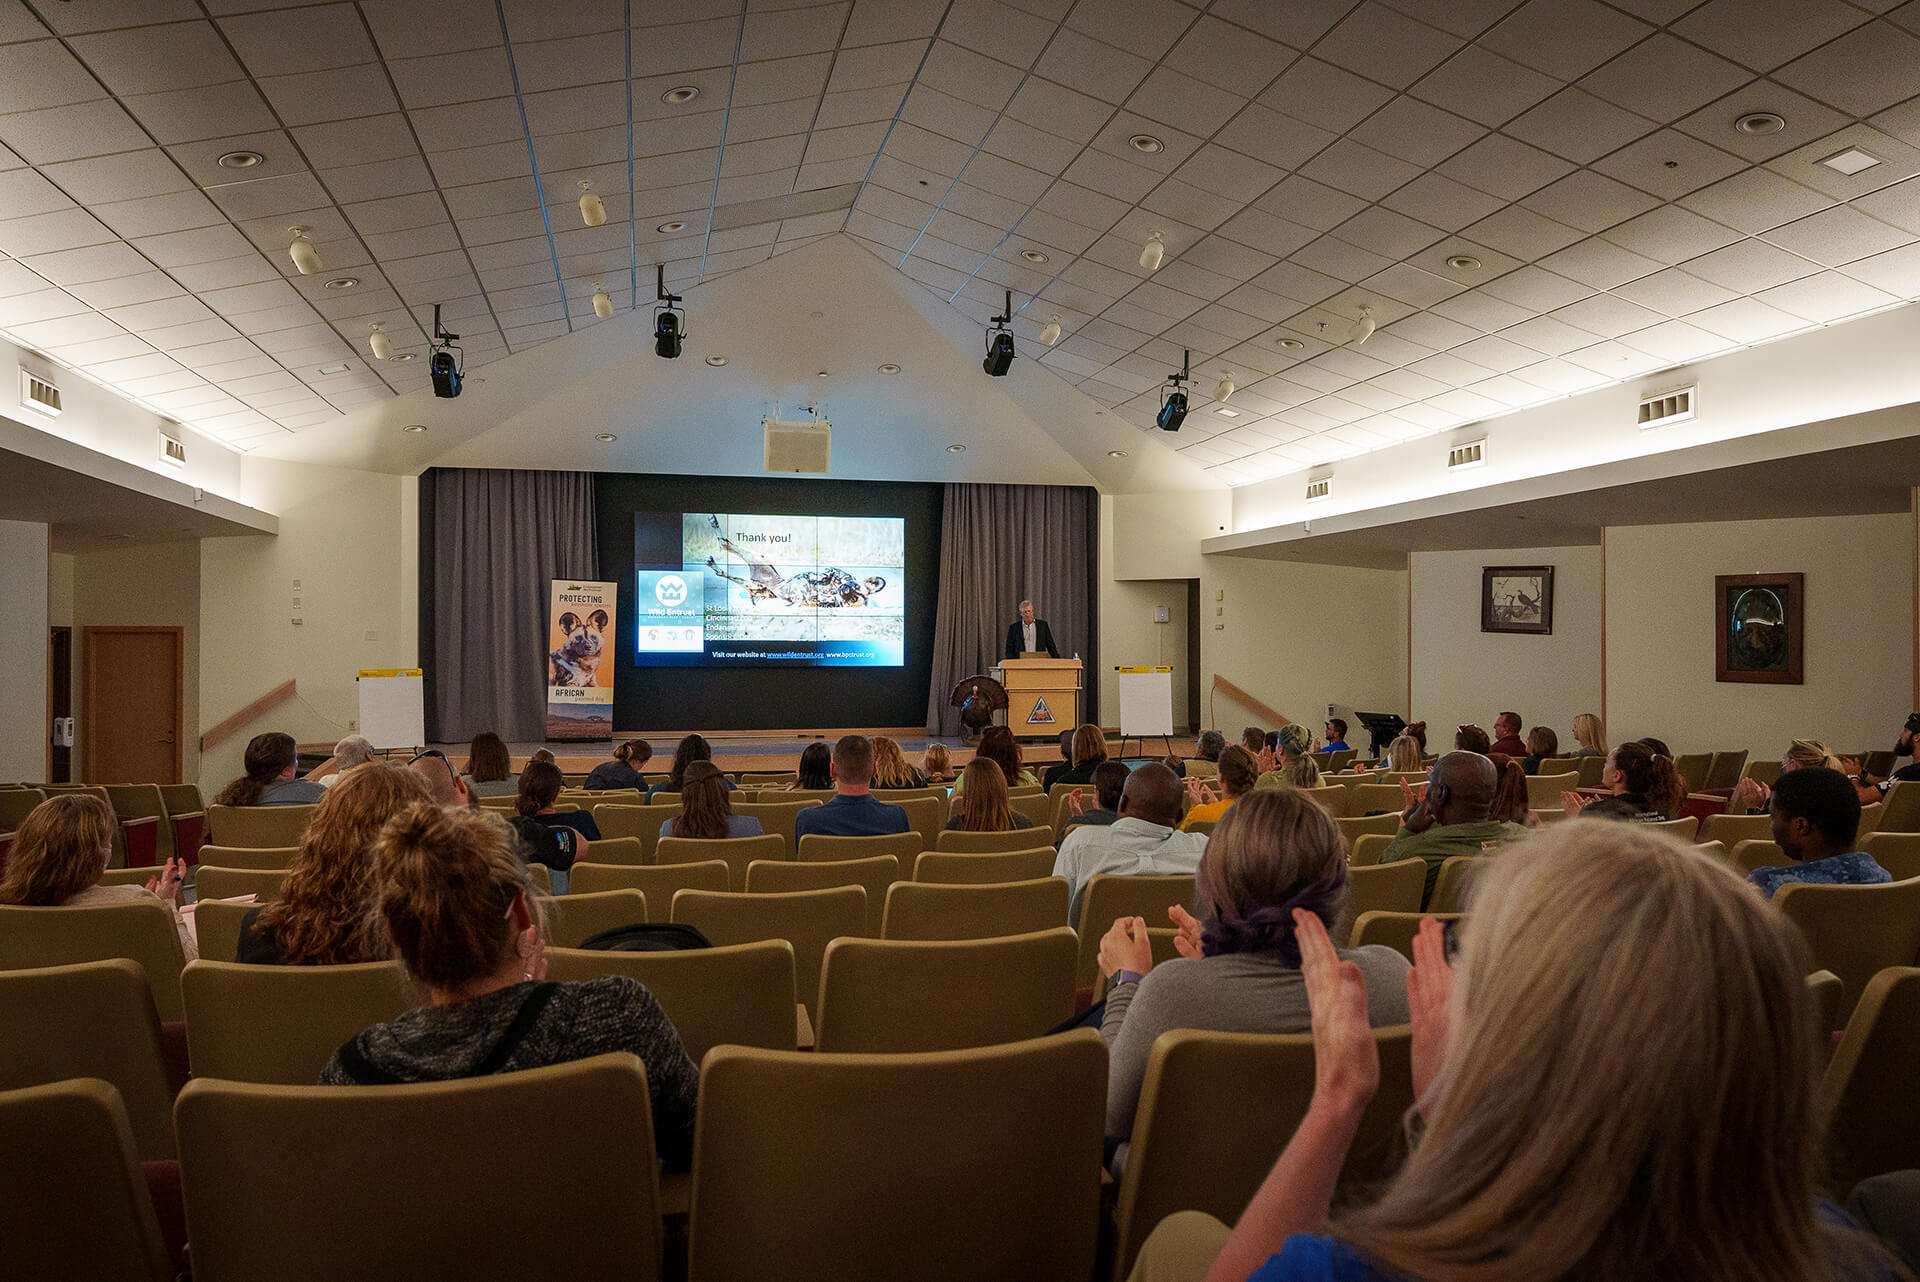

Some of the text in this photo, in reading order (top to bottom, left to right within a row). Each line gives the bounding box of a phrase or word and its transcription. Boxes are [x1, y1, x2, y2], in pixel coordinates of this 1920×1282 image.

[736, 532, 791, 544] Thank you!
[559, 594, 602, 603] PROTECTING
[648, 608, 696, 616] Wild Entrust
[555, 689, 585, 697] AFRICAN
